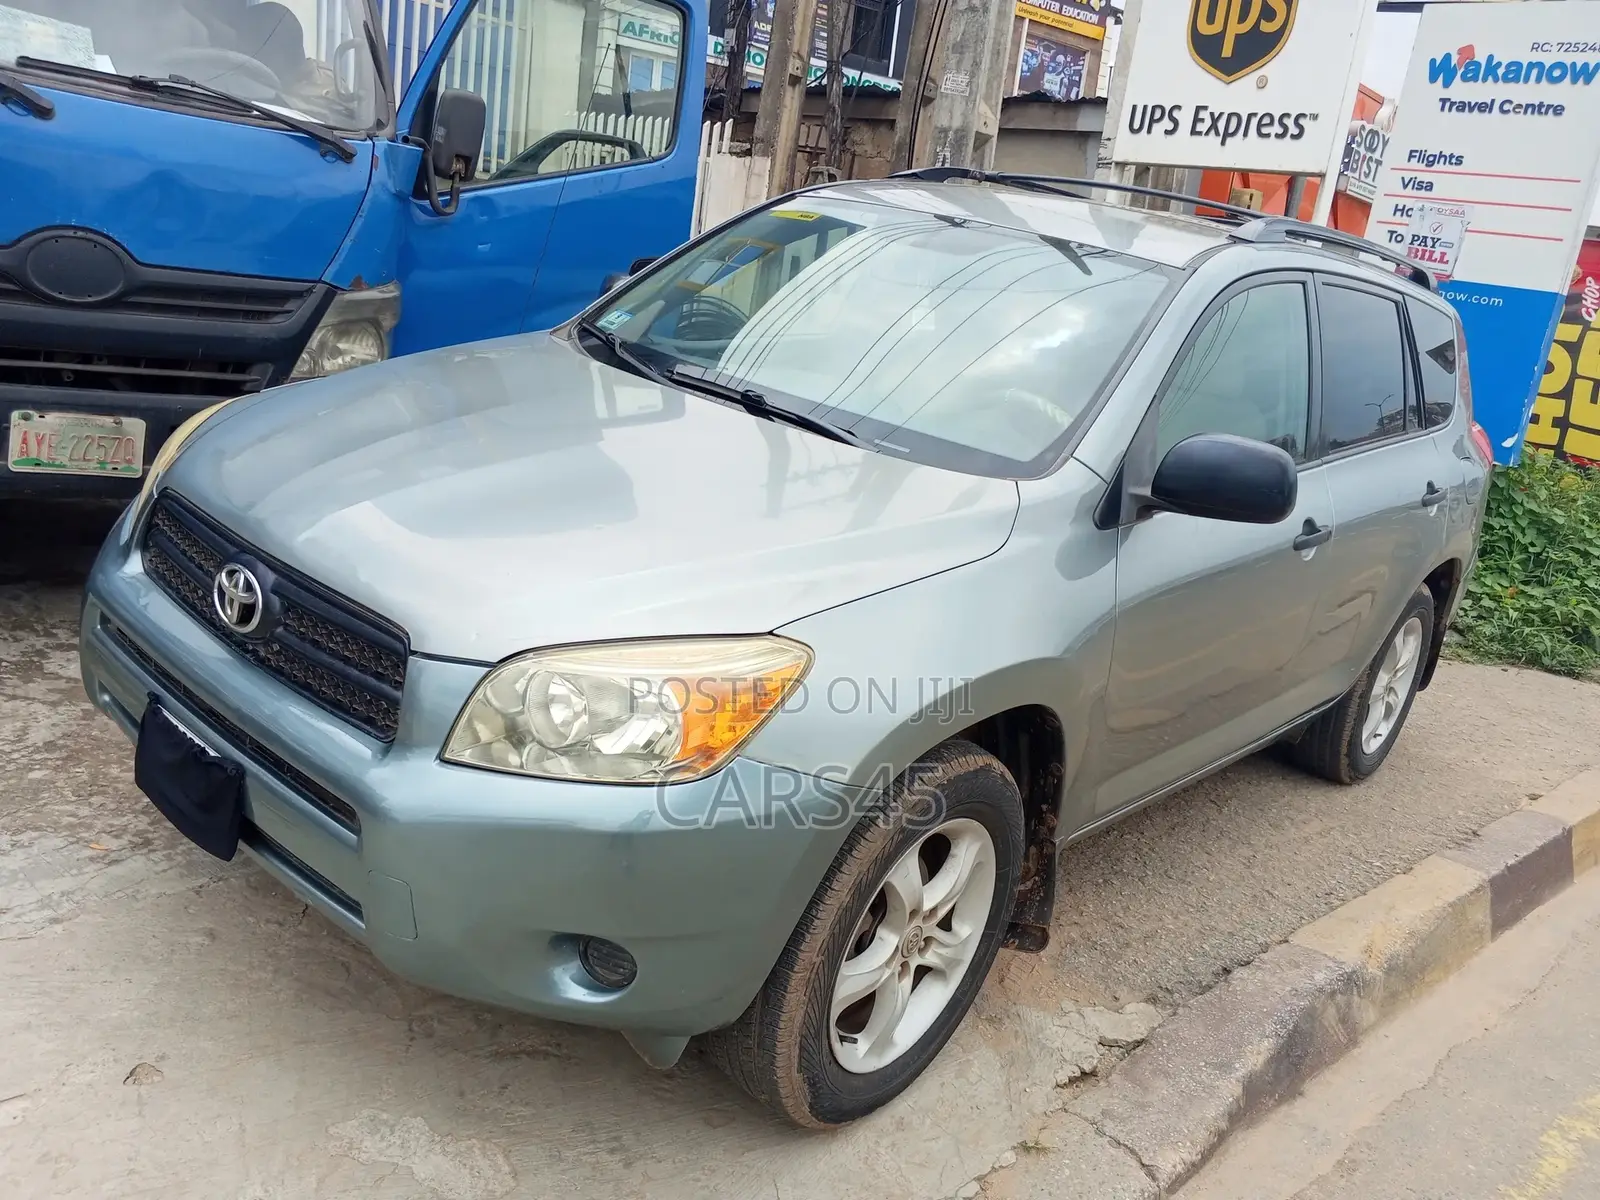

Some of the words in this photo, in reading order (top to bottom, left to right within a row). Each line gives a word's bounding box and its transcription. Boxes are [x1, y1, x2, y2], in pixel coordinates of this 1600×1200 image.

[1018, 6, 1038, 16] Unleash
[1039, 13, 1050, 21] your
[1061, 6, 1099, 24] EDUCATION
[1530, 42, 1553, 53] RC:
[1429, 48, 1600, 88] Wakanow
[1439, 98, 1496, 114] Travel
[1499, 100, 1566, 116] Centre
[1129, 104, 1182, 135] UPS
[1408, 150, 1464, 167] Flights
[1401, 177, 1434, 192] Visa
[1409, 234, 1441, 249] PAY
[1406, 246, 1449, 265] BILL
